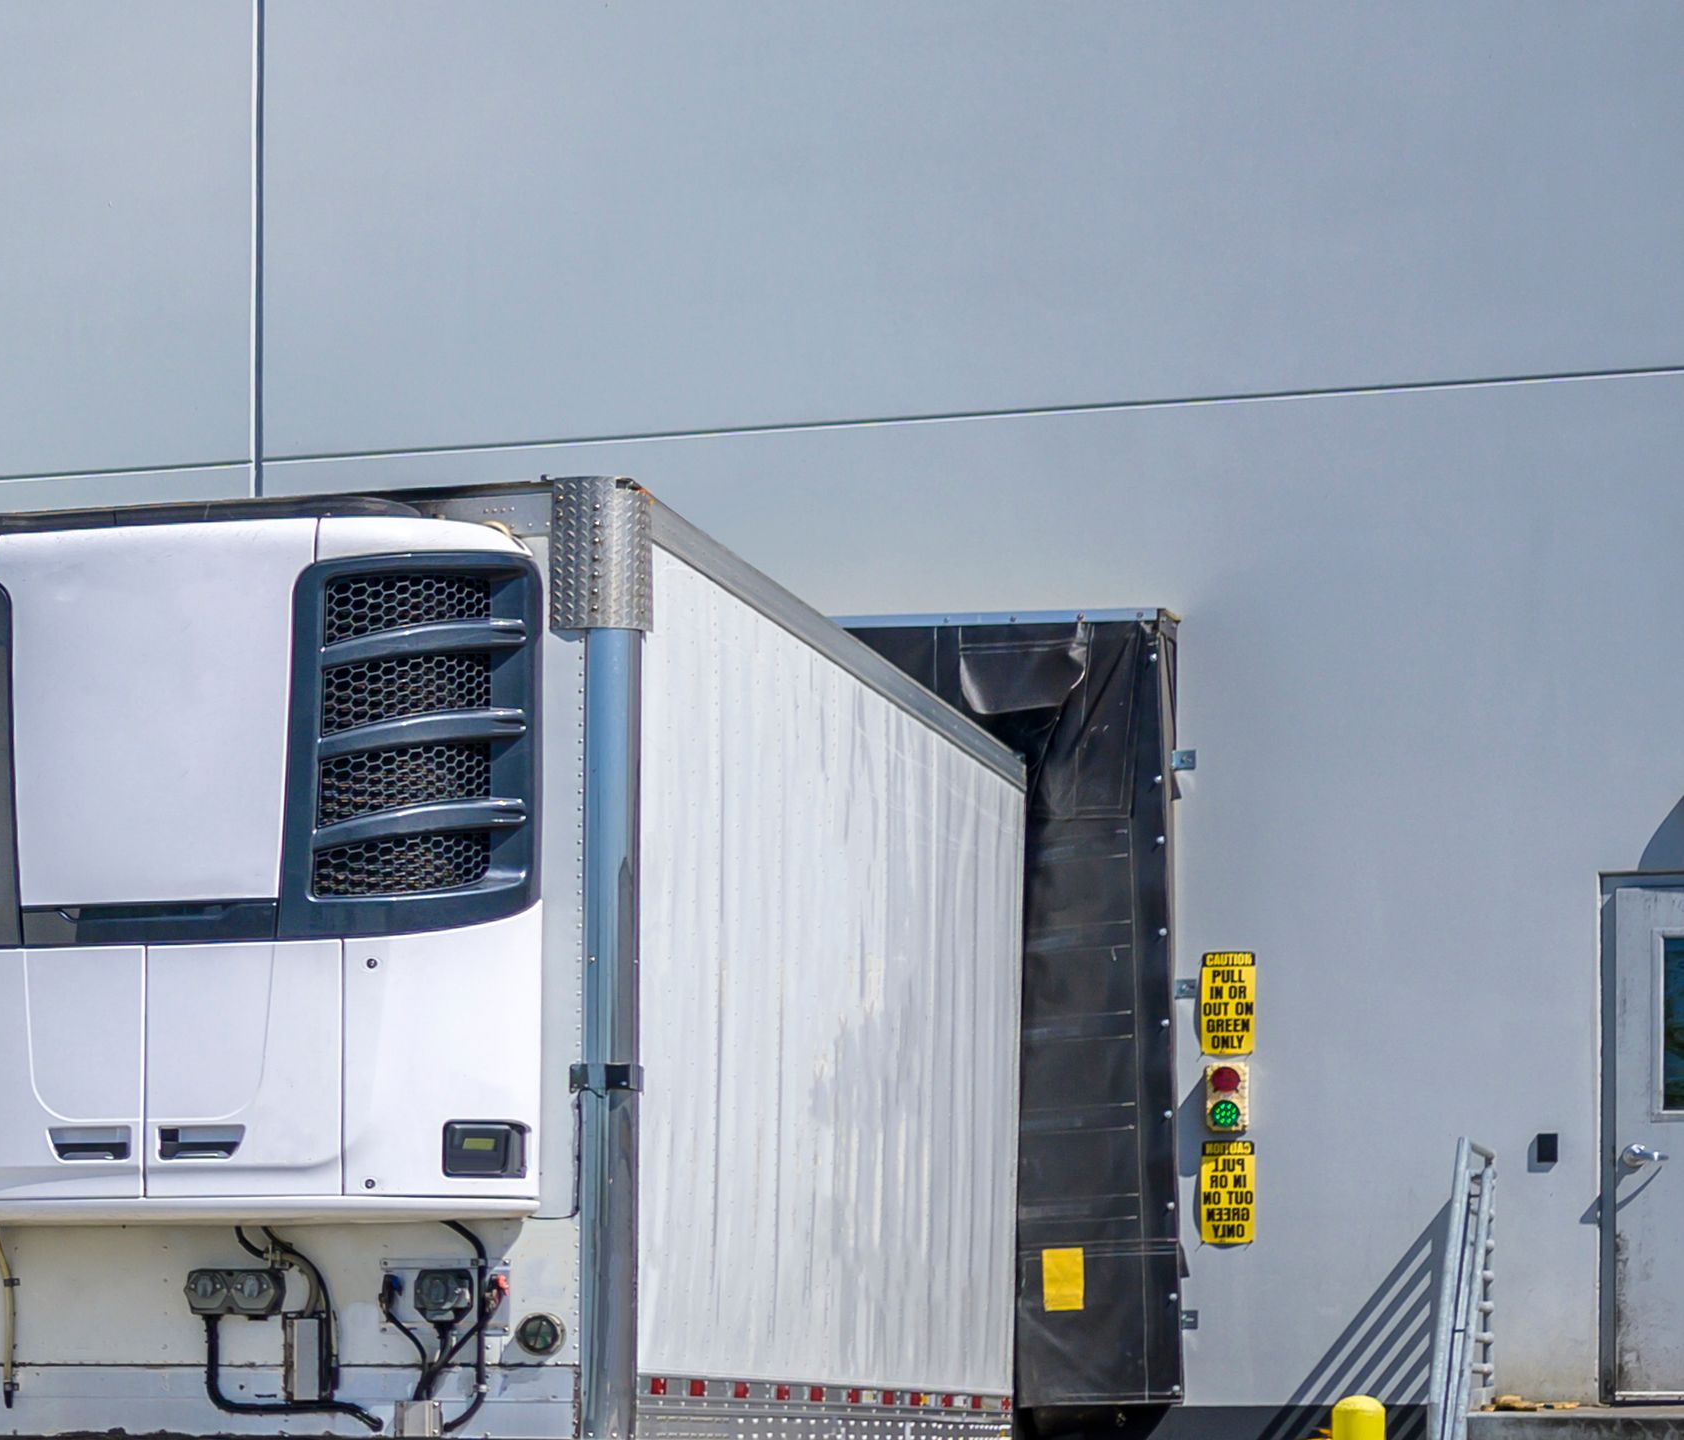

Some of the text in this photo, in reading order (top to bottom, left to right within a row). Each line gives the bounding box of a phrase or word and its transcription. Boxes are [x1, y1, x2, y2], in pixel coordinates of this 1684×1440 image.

[1206, 954, 1252, 966] CAUTION
[1212, 970, 1245, 983] PULL
[1210, 986, 1247, 1000] IN OR
[1203, 1003, 1254, 1016] OUT ON
[1206, 1019, 1250, 1033] GREEN
[1211, 1036, 1244, 1049] ONLY
